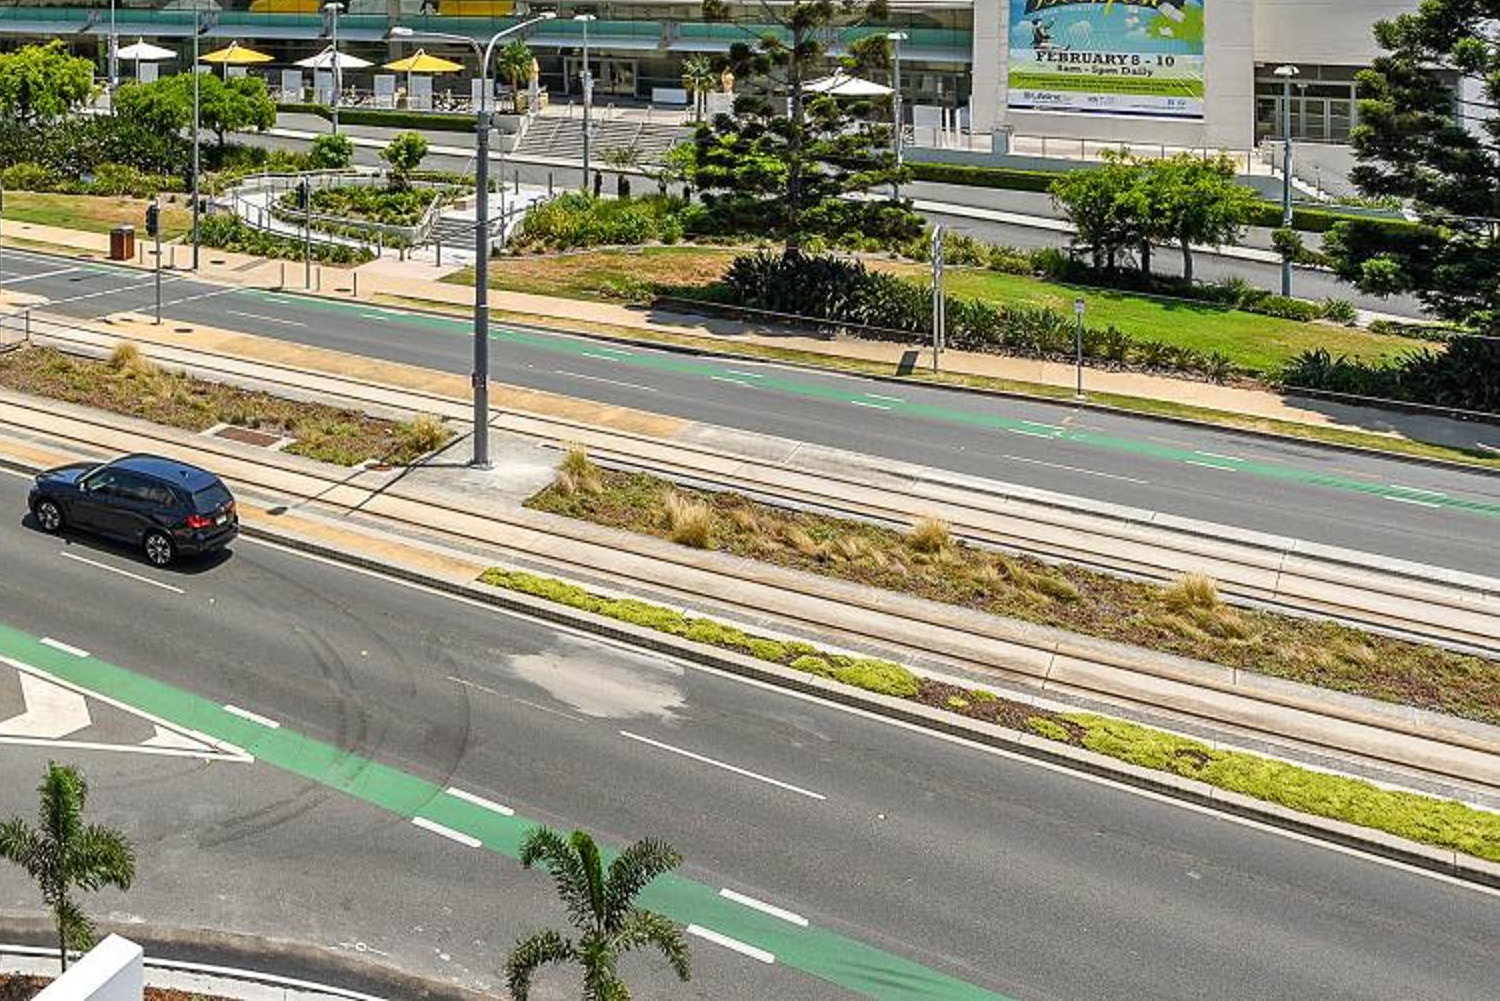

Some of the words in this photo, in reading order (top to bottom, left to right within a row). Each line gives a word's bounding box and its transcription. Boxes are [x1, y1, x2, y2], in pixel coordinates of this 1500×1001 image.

[1036, 51, 1128, 66] FEBRUARY
[1131, 54, 1141, 66] 8
[1156, 54, 1175, 68] 10
[1121, 66, 1154, 78] Daily
